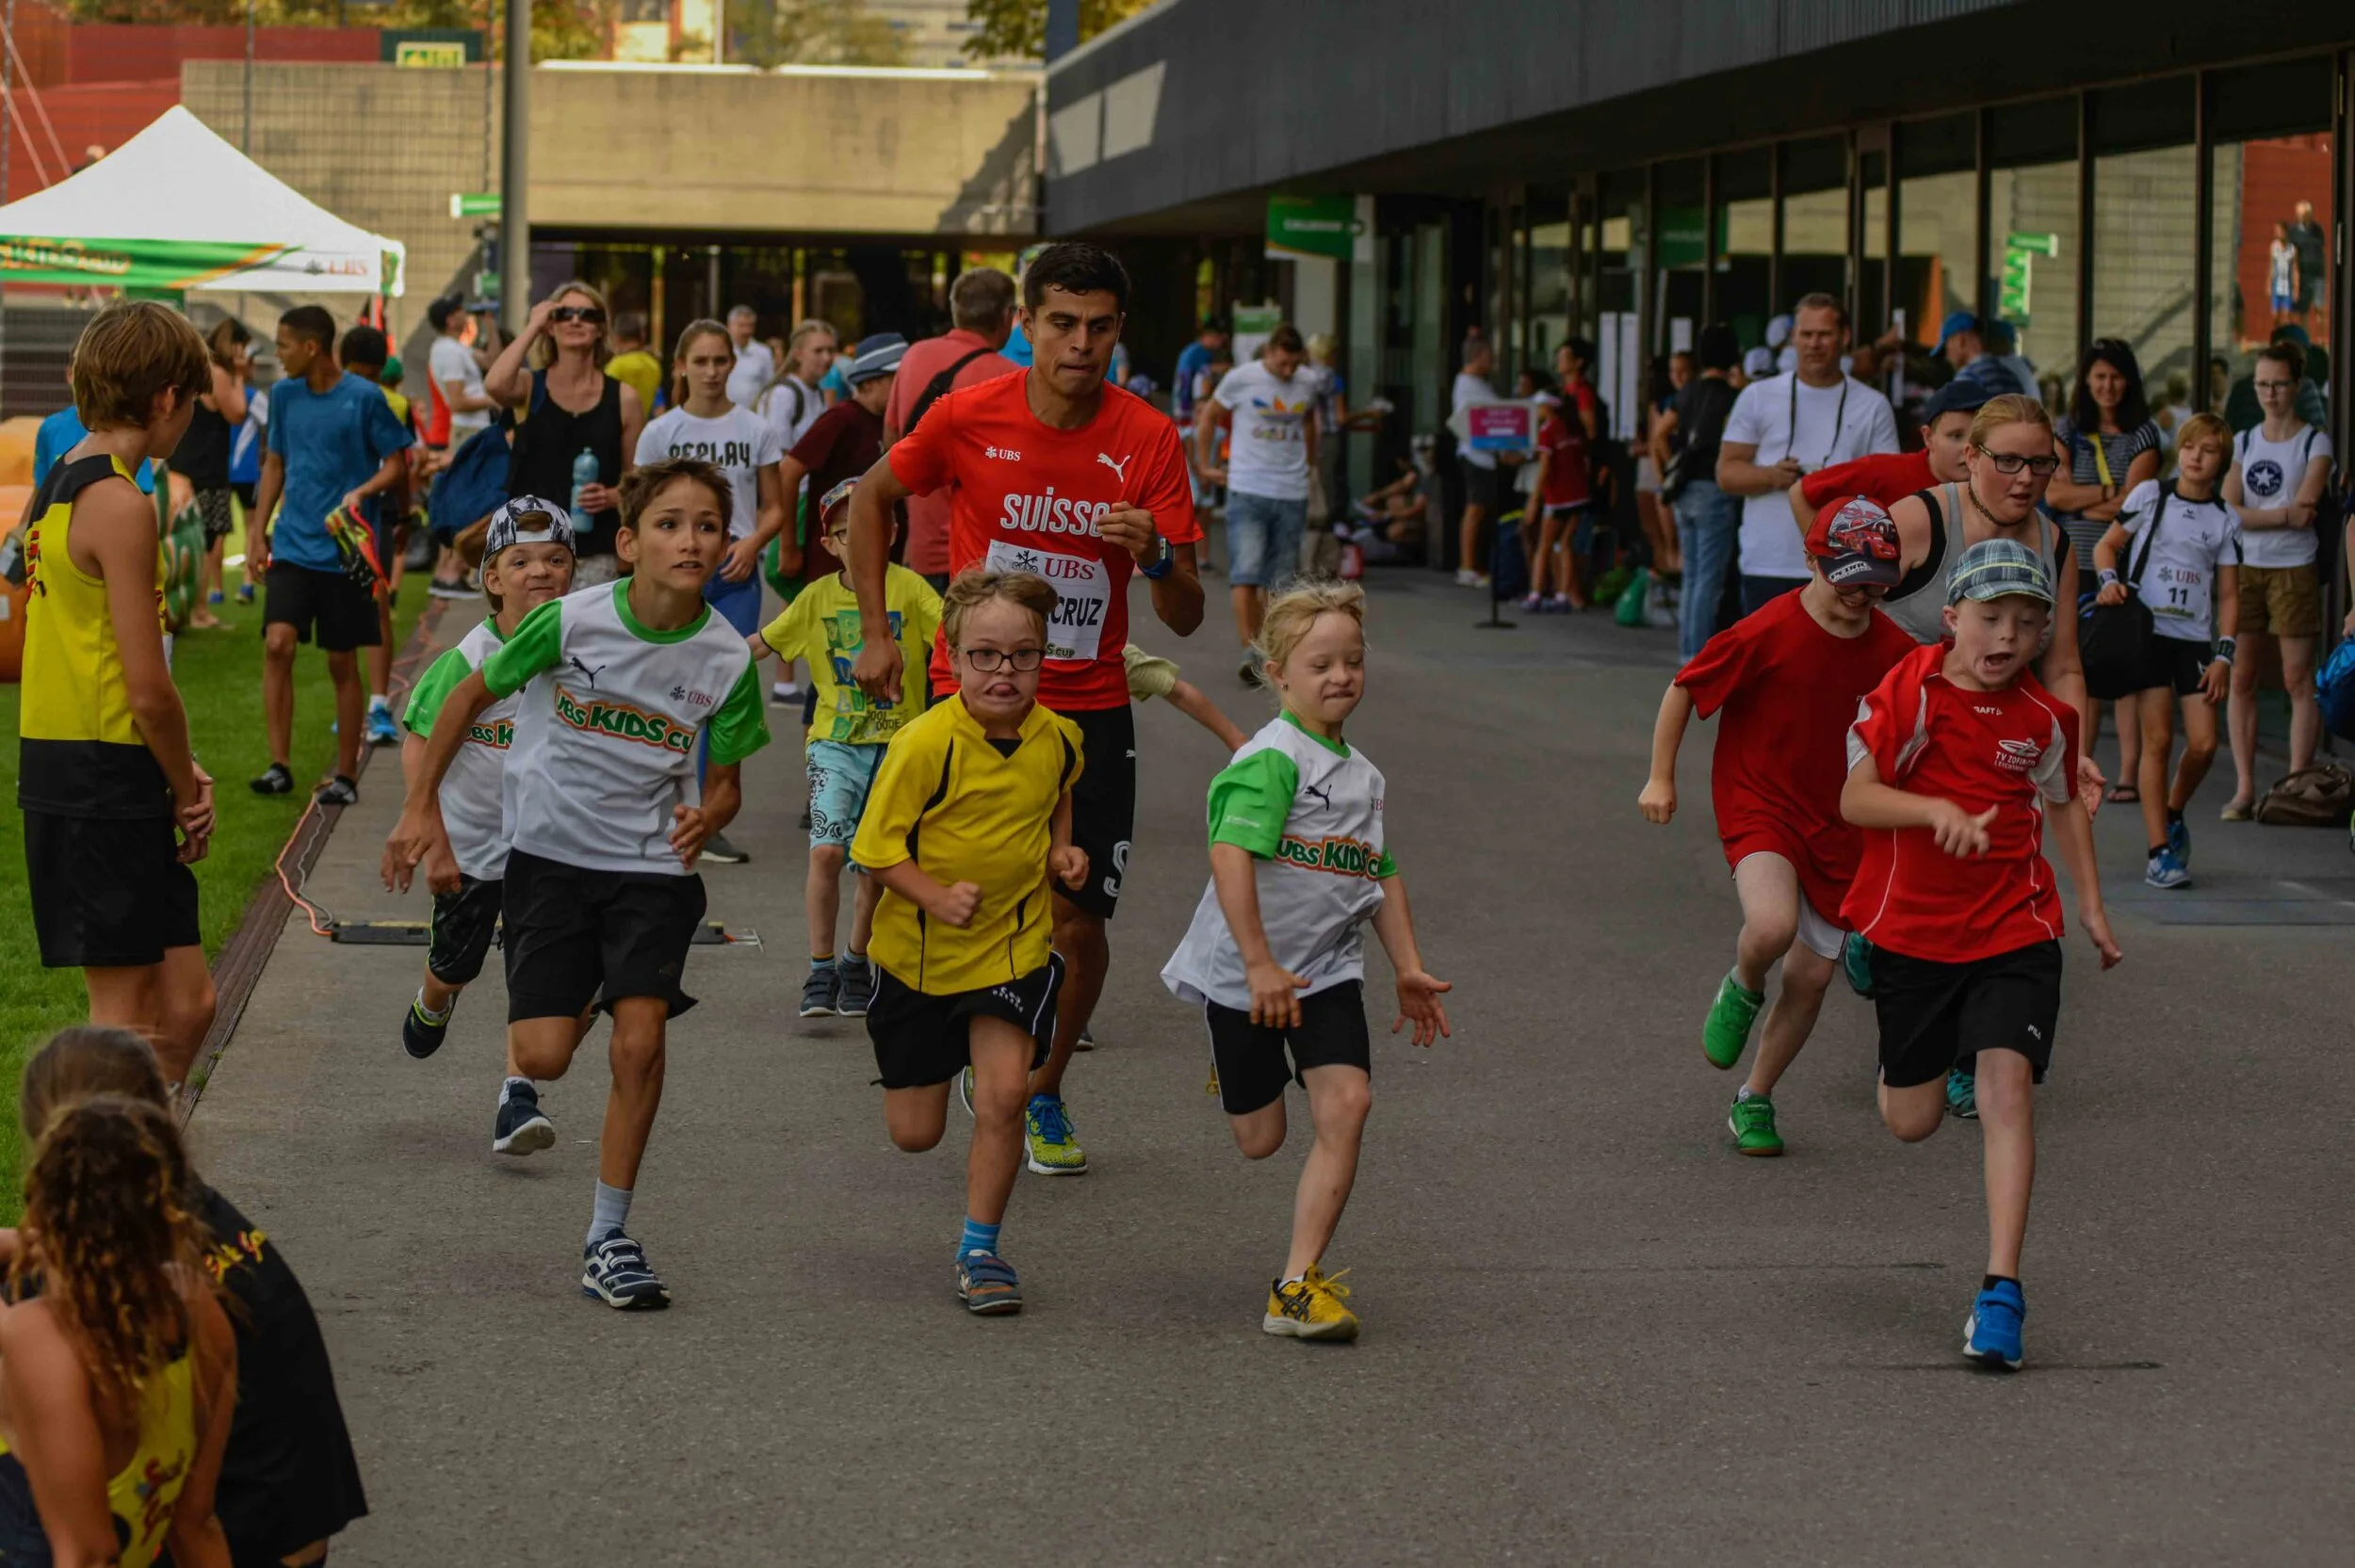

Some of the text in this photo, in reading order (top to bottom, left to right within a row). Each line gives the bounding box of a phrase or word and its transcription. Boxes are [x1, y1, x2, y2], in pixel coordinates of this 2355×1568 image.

[999, 448, 1021, 461] UBS
[1044, 557, 1095, 580] UBS
[2175, 569, 2201, 585] UBS
[2168, 588, 2188, 606] 11
[1046, 595, 1103, 627] CRUZ
[687, 691, 713, 707] UBS
[589, 704, 669, 743] KIDS
[1996, 751, 2006, 762] TV
[1276, 839, 1321, 866] UBS
